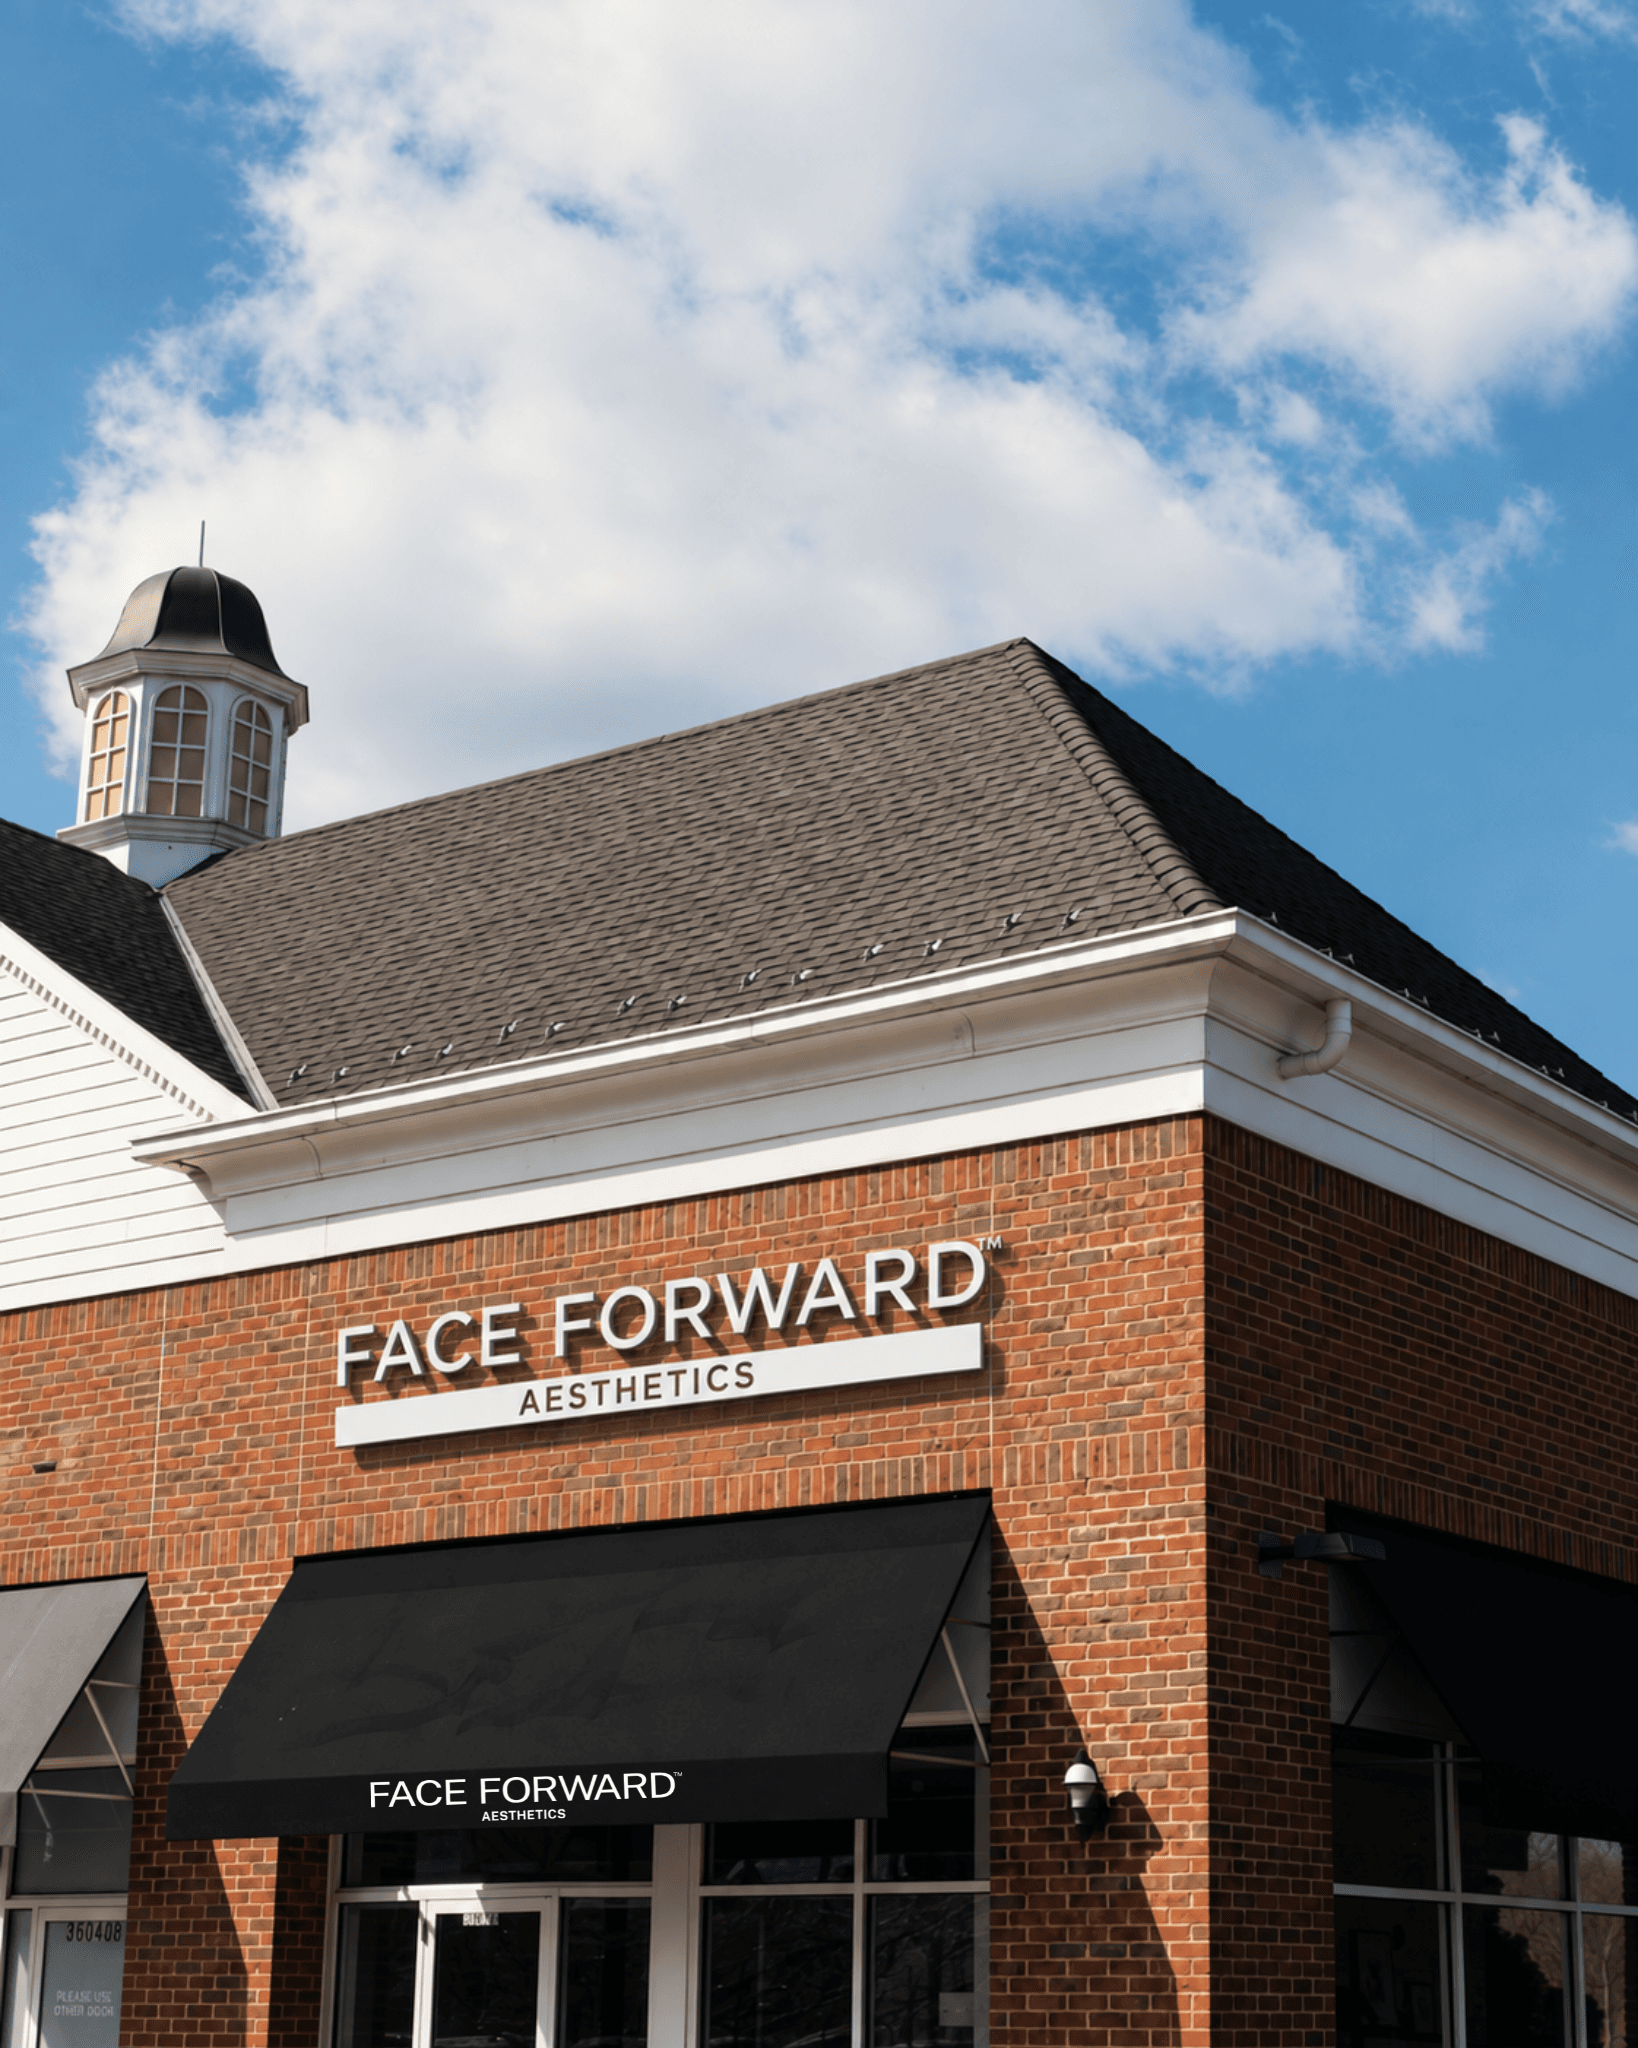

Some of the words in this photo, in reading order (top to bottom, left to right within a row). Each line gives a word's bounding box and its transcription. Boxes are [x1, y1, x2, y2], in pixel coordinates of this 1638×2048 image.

[336, 1303, 523, 1387] FACE
[519, 1361, 756, 1416] AESTHETICS
[369, 1778, 468, 1808] FACE
[481, 1808, 567, 1822] AESTHETICS
[66, 1921, 122, 1942] 360408
[56, 1990, 92, 2003] PLEASE
[94, 1990, 112, 2003] USE
[53, 2005, 84, 2017] OTHER
[87, 2005, 115, 2017] DOOR
